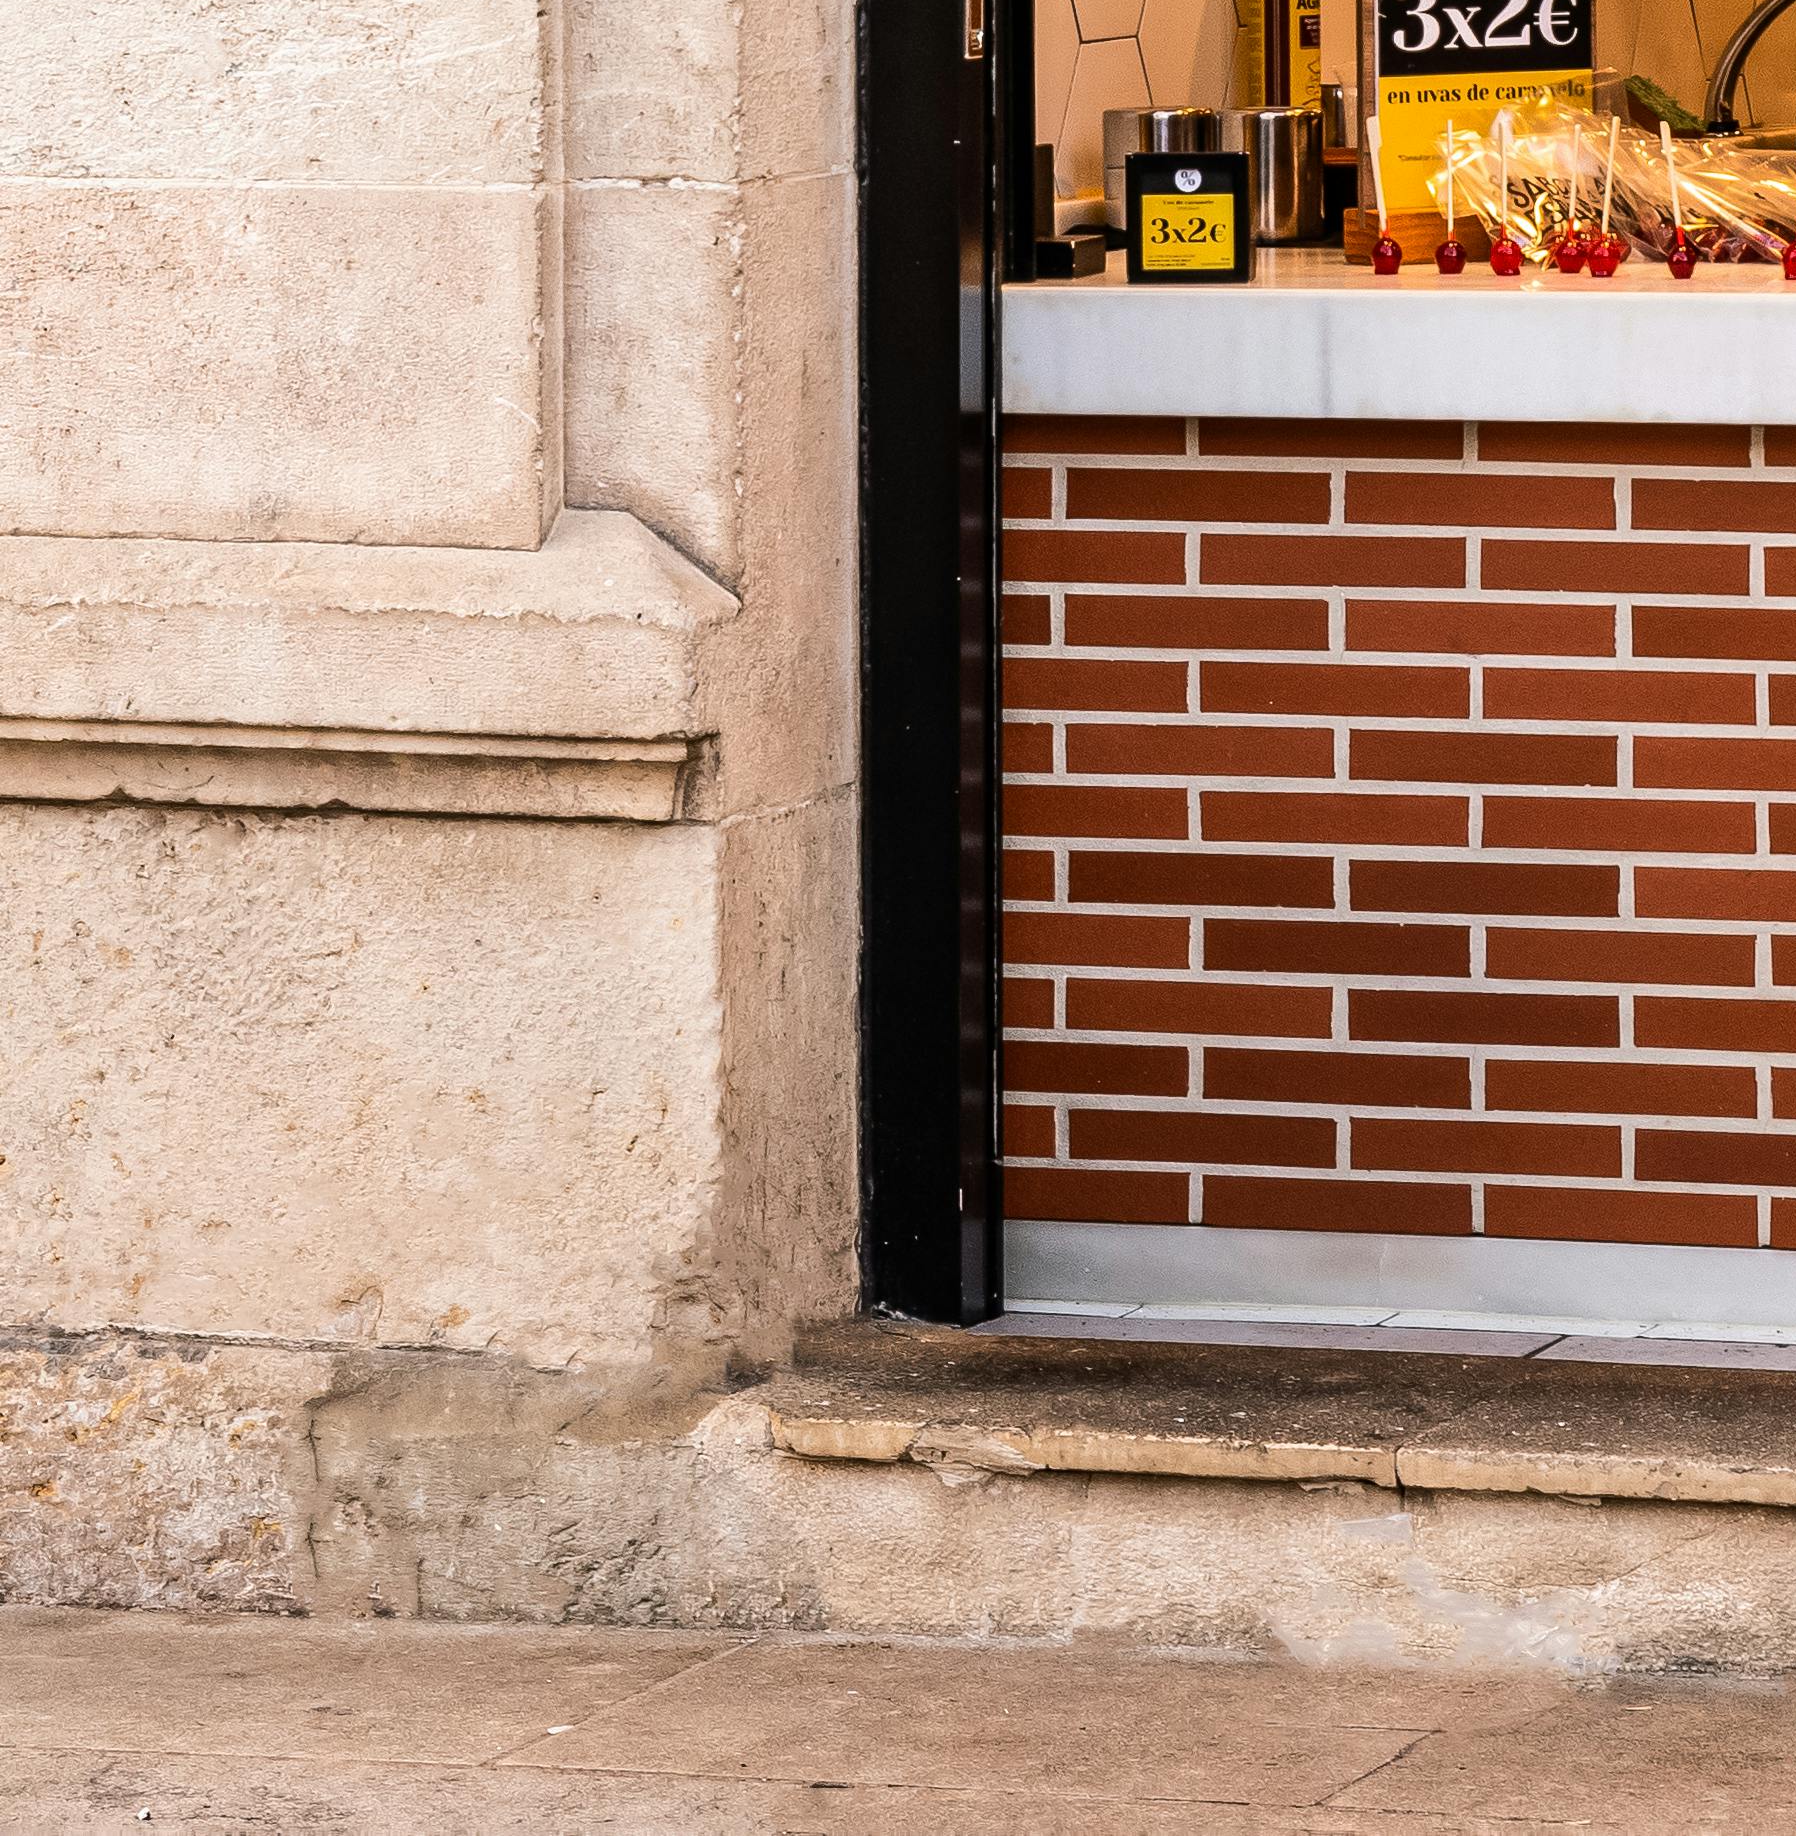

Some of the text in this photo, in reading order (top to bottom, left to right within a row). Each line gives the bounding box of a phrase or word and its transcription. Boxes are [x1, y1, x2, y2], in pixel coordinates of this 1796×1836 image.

[1387, 90, 1410, 105] en
[1417, 87, 1461, 103] uvas
[1467, 83, 1489, 101] de
[1150, 217, 1227, 244] 3x2€
